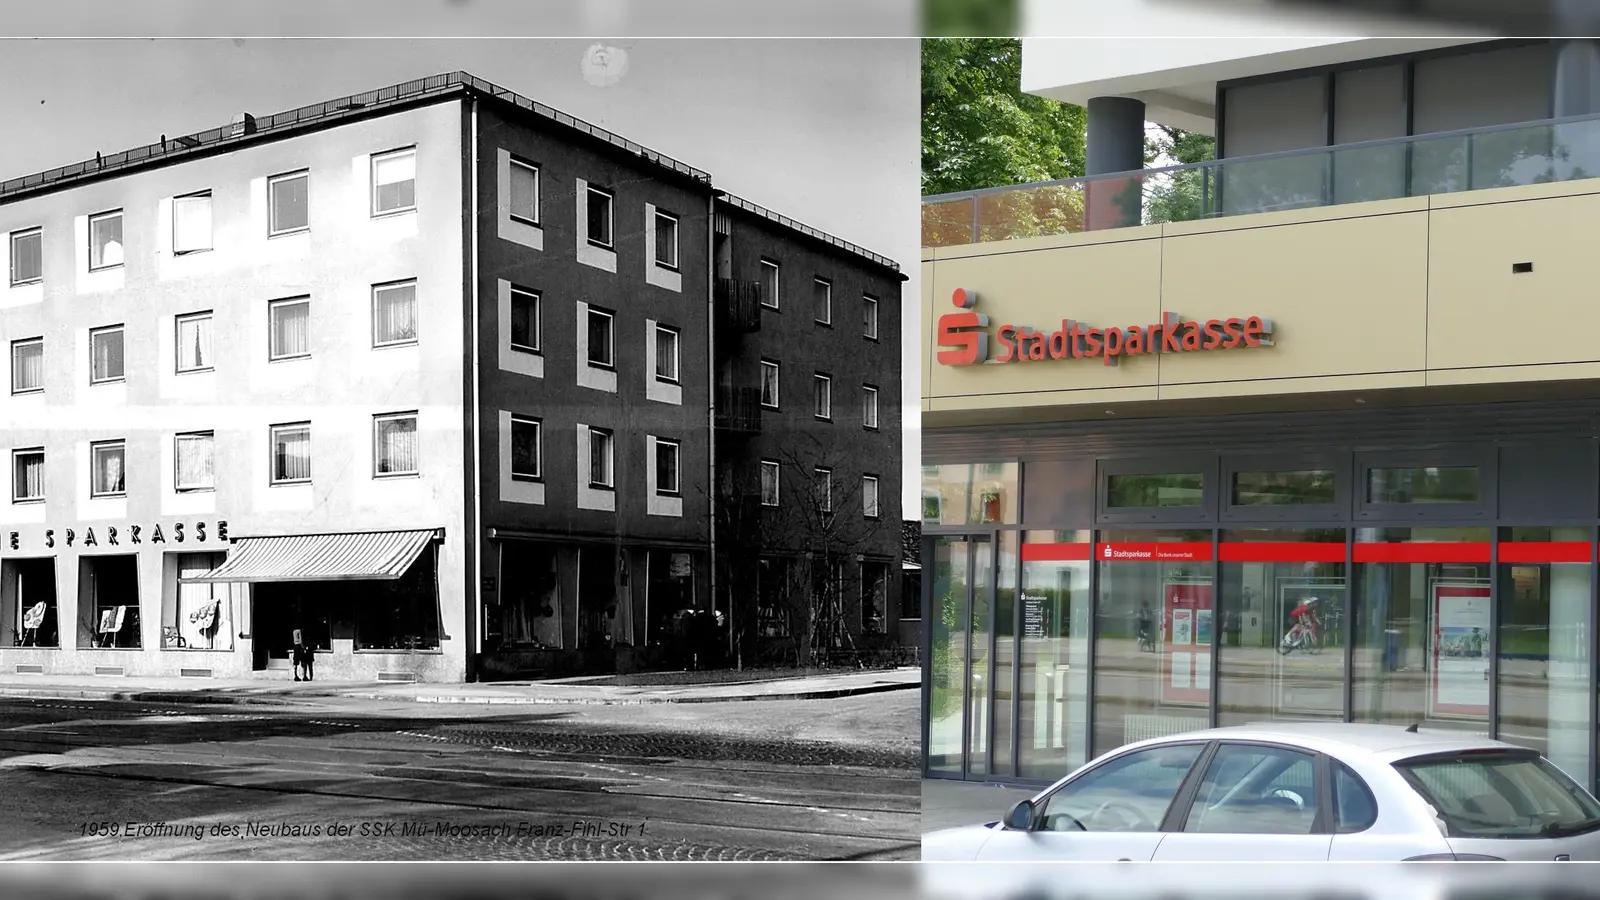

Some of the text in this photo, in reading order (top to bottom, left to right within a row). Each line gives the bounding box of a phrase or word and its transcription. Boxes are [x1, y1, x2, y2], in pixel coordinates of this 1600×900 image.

[995, 311, 1274, 367] Stadtsparkasse
[45, 520, 228, 547] SPARKASSE
[1113, 550, 1152, 558] Stadtsparkasse
